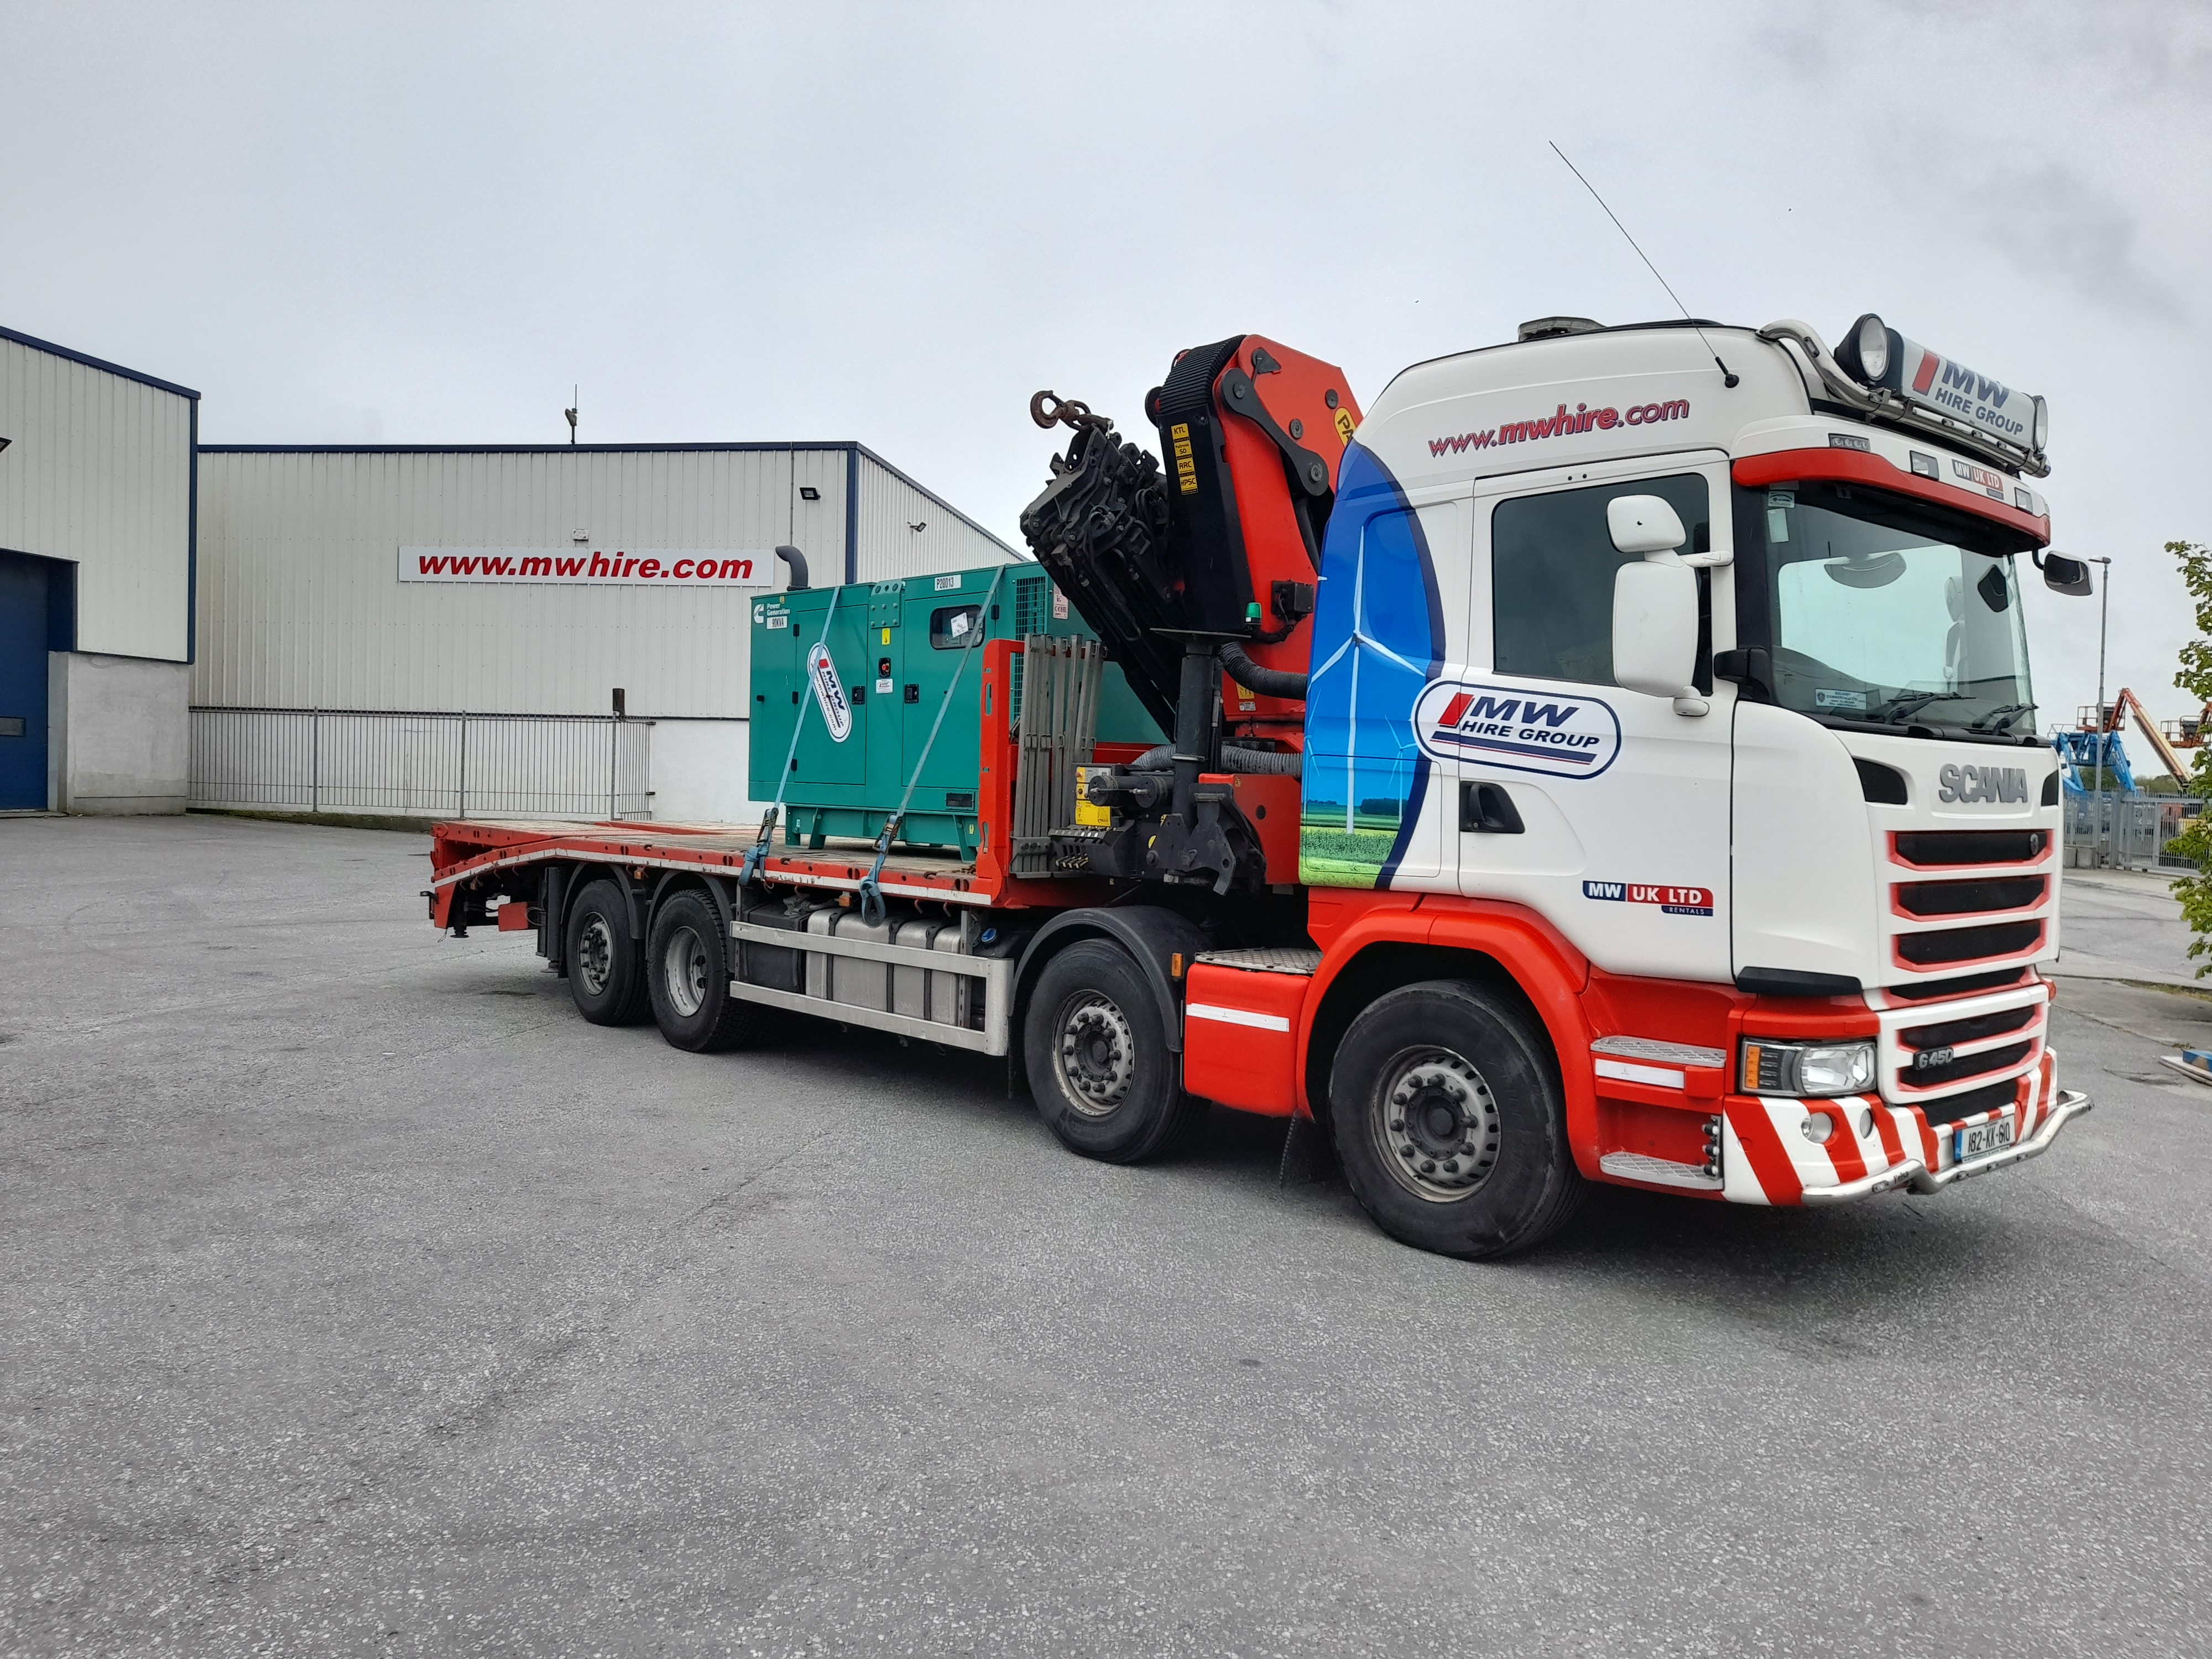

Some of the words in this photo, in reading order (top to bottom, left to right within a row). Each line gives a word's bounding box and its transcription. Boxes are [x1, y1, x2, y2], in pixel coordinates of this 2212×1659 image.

[1942, 360, 2010, 409] MW
[1935, 387, 1973, 414] HIRE
[1975, 406, 2023, 435] GROUP
[1173, 426, 1186, 435] KTL
[1428, 399, 1689, 458] www.mwhire.com
[1179, 461, 1192, 469] RRC
[1954, 461, 1970, 478] MW
[1973, 468, 1985, 484] UK
[1986, 473, 2000, 488] LTD
[419, 551, 753, 579] www.mwhire.com
[936, 577, 954, 589] P20013
[822, 671, 832, 692] HIRE
[830, 695, 844, 727] GROUP
[826, 670, 845, 711] MW
[1470, 696, 1580, 727] MW
[1462, 720, 1514, 737] HIRE
[1519, 728, 1600, 748] GROUP
[1939, 764, 2028, 803] SCANIA
[1588, 883, 1621, 898] MW
[1633, 886, 1660, 901] UK
[1668, 889, 1702, 904] LTD
[1669, 907, 1705, 915] RENTALS
[1919, 1053, 1929, 1068] G
[1929, 1048, 1954, 1066] 450
[1968, 1121, 2010, 1153] 182-KK-610
